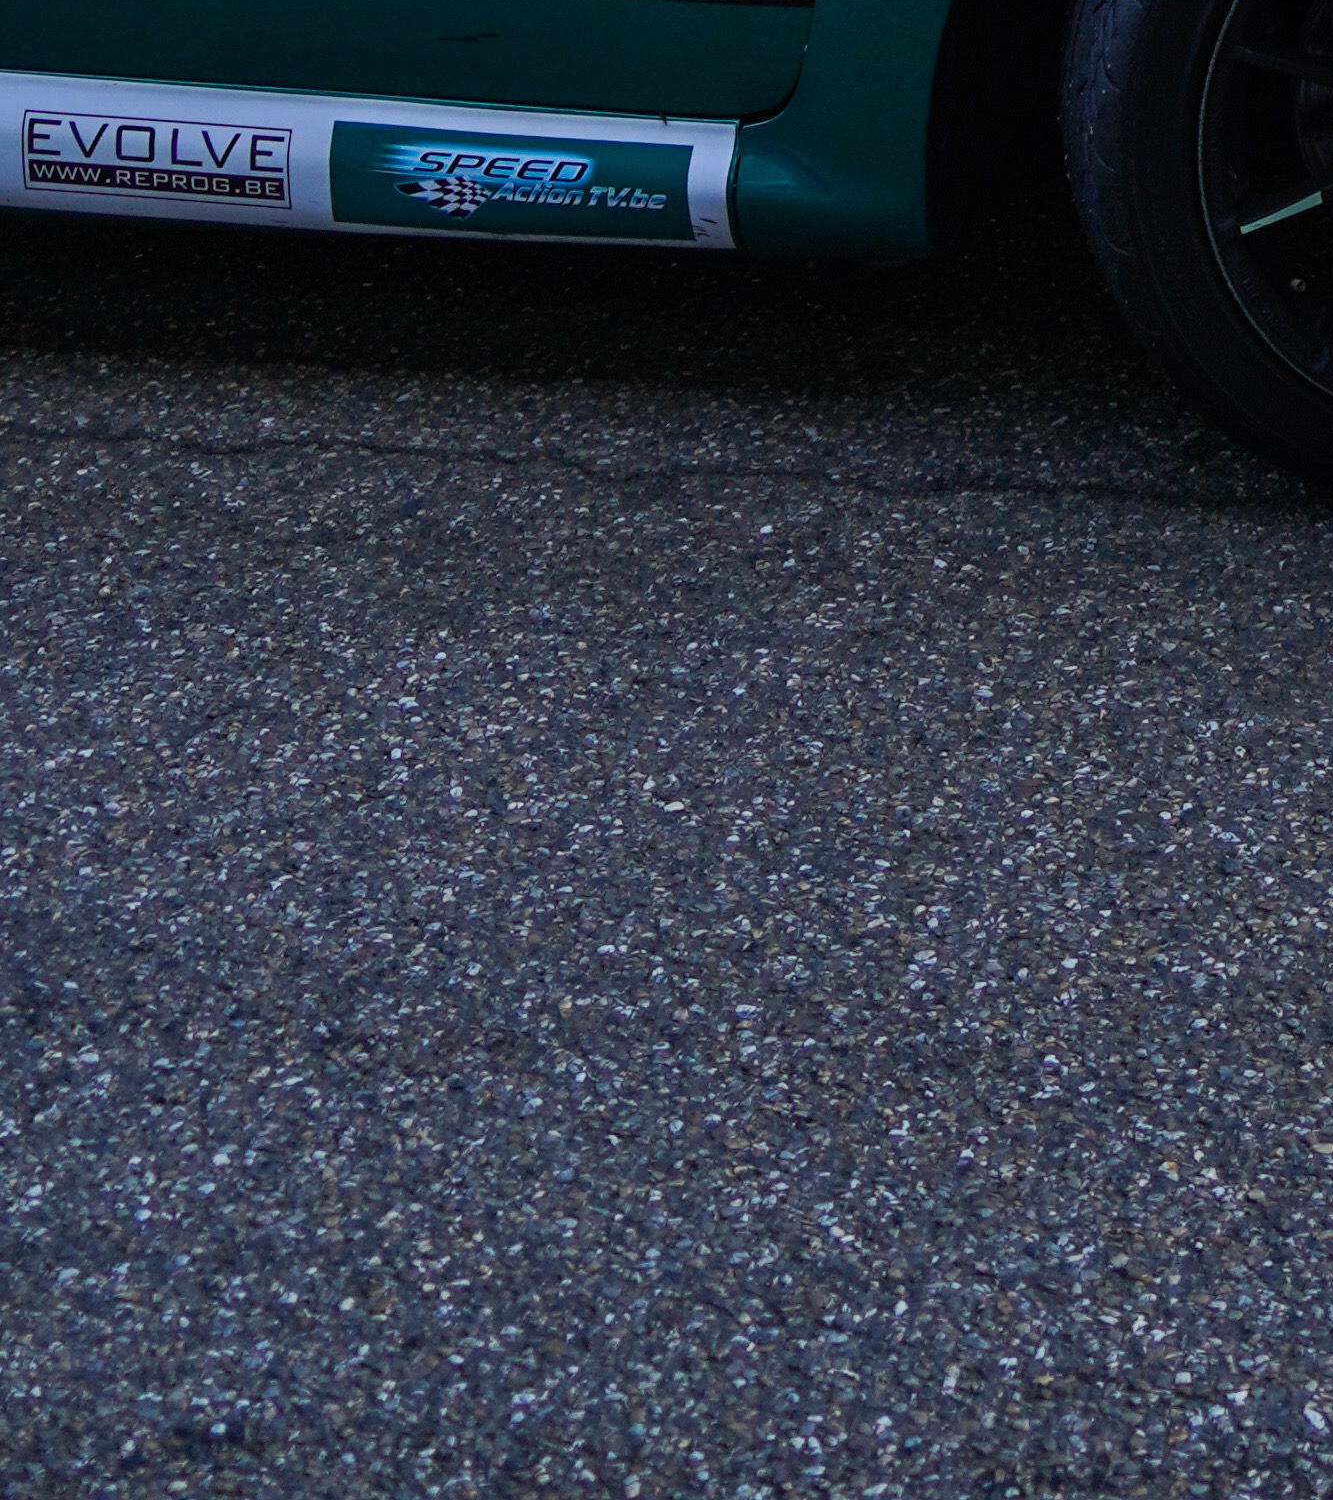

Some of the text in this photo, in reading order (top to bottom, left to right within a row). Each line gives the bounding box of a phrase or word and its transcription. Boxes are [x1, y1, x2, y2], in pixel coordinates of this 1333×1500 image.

[27, 117, 286, 174] EVOLVE
[32, 163, 282, 198] WWW.REPROG.BE
[413, 151, 589, 183] SPEED
[491, 181, 667, 210] Action TV.be
